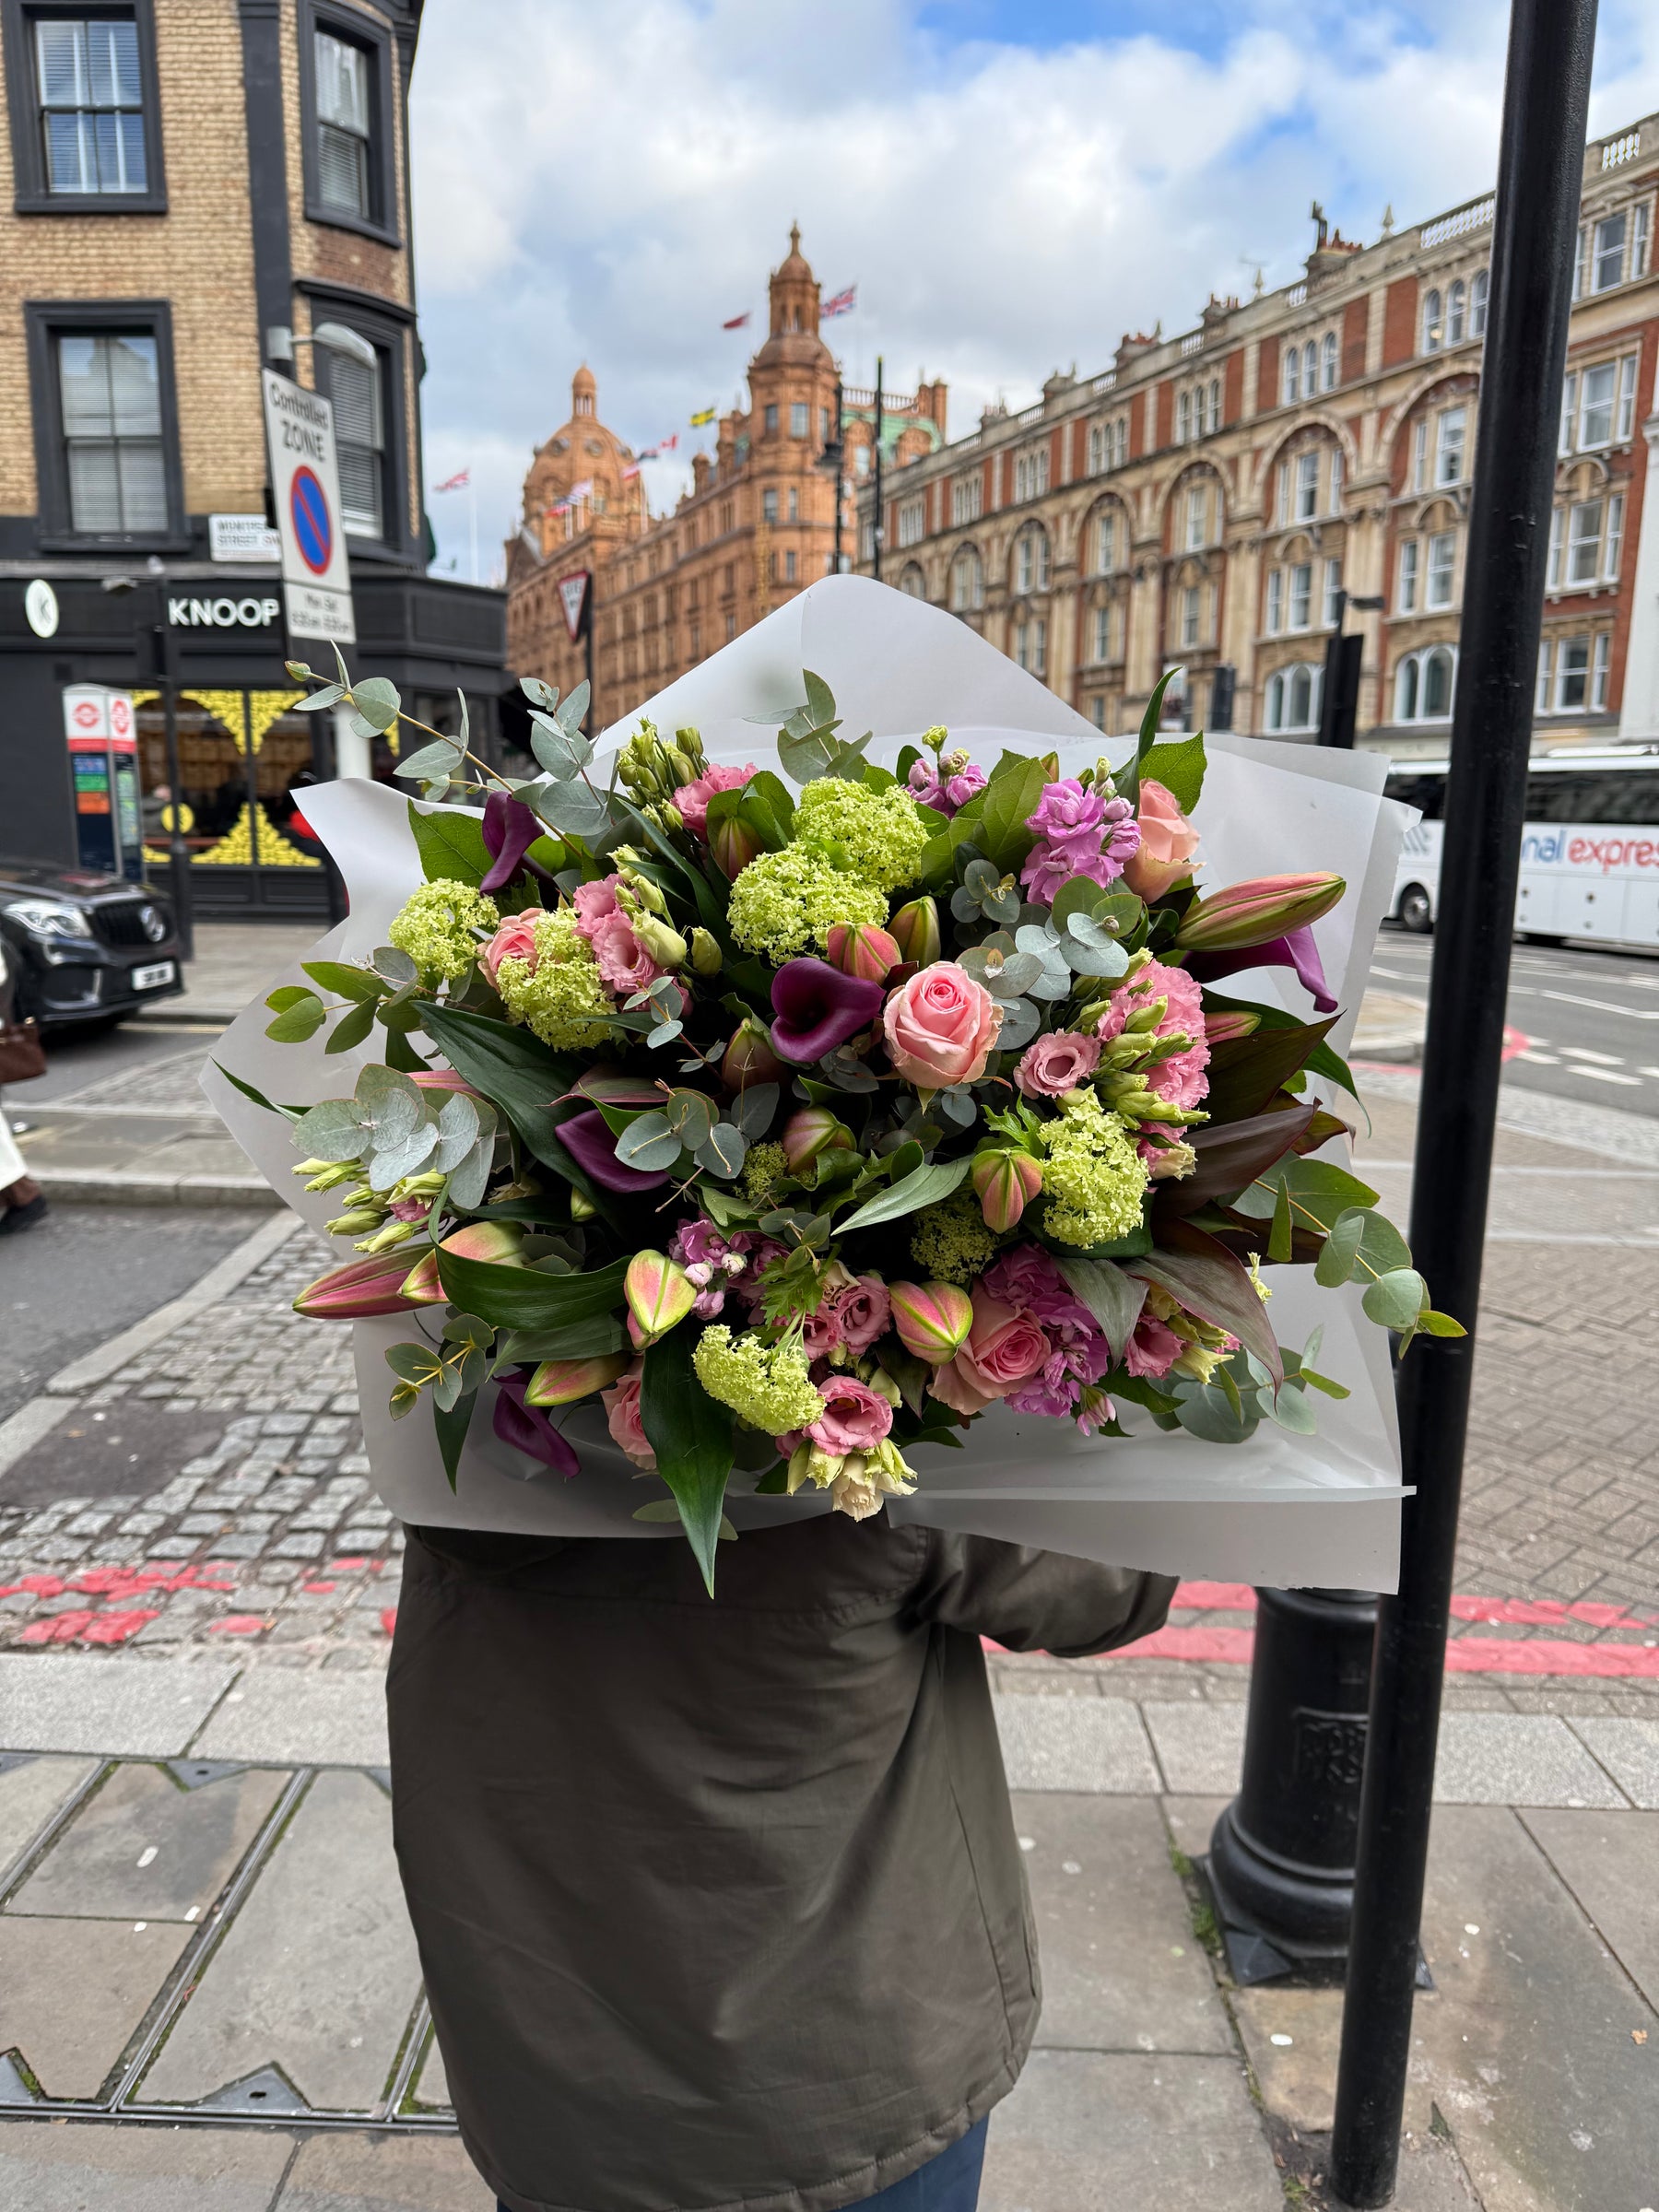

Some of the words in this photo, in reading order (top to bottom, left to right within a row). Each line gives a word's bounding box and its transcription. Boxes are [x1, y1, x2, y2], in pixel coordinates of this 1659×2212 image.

[269, 382, 329, 430] Controlled
[280, 418, 326, 463] ZONE
[168, 597, 280, 627] KNOOP
[1521, 830, 1566, 863] nal
